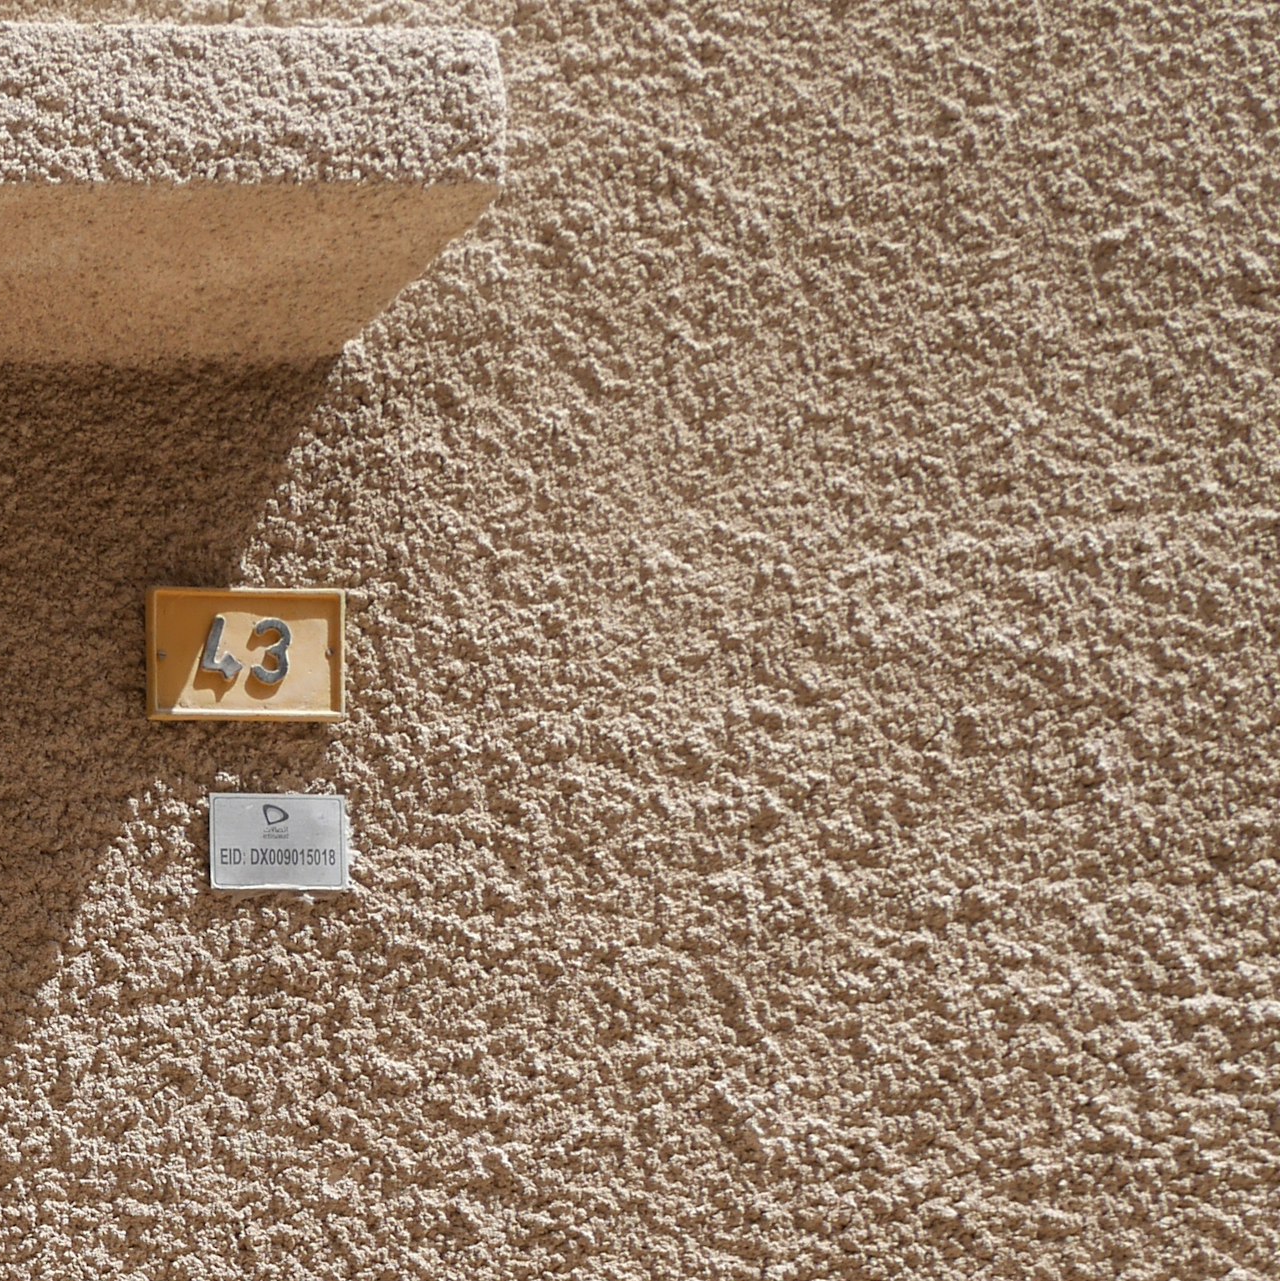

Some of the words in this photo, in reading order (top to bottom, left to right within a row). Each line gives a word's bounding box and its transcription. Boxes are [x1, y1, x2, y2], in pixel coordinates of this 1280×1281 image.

[202, 614, 292, 685] 43
[220, 848, 246, 865] EID:
[251, 848, 336, 866] DX009015018
